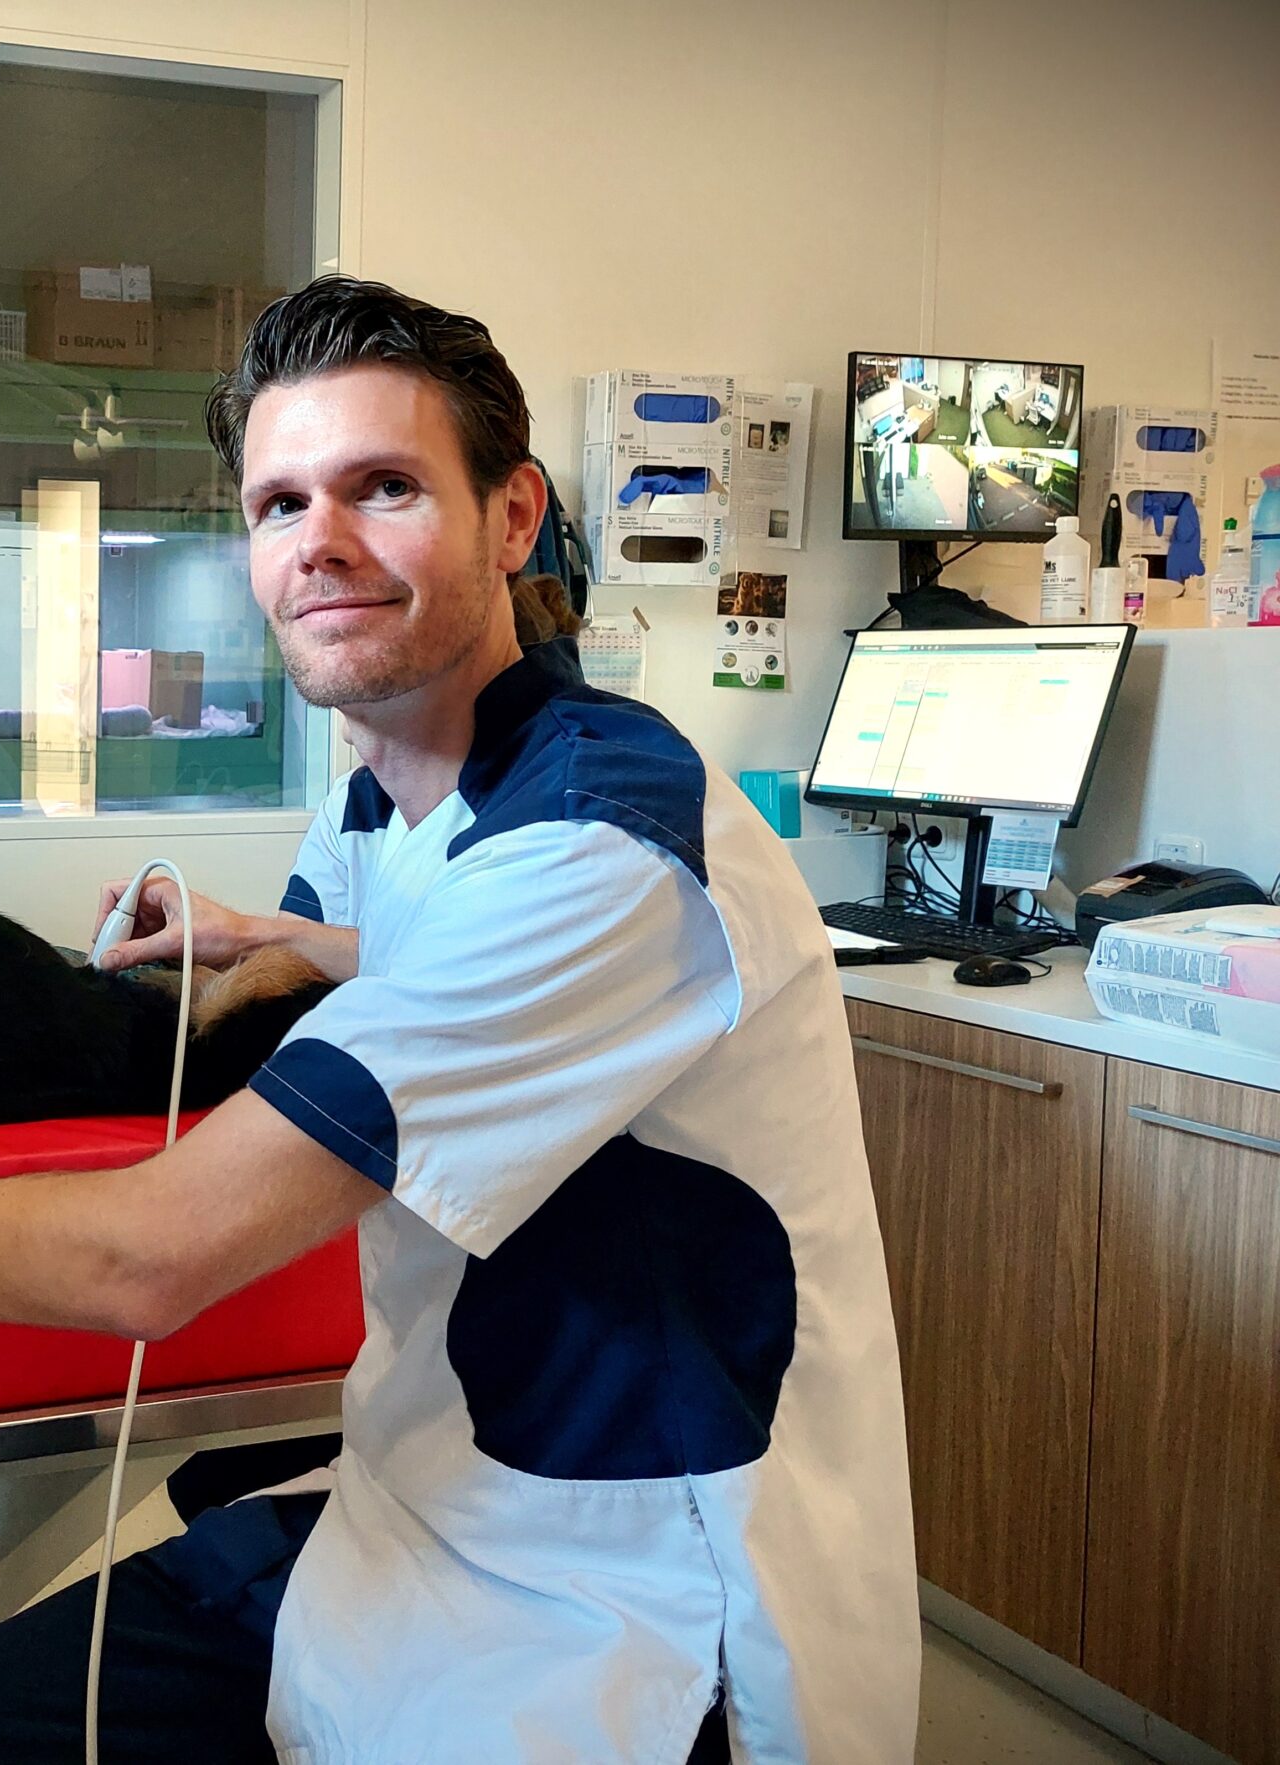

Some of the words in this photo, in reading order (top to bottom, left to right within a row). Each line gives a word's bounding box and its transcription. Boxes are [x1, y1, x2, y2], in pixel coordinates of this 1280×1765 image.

[59, 335, 68, 346] B
[74, 336, 127, 350] BRAUN
[618, 444, 626, 454] M
[722, 447, 731, 488] NITRILE
[713, 517, 722, 557] NITRILE
[1215, 586, 1238, 595] NaCl
